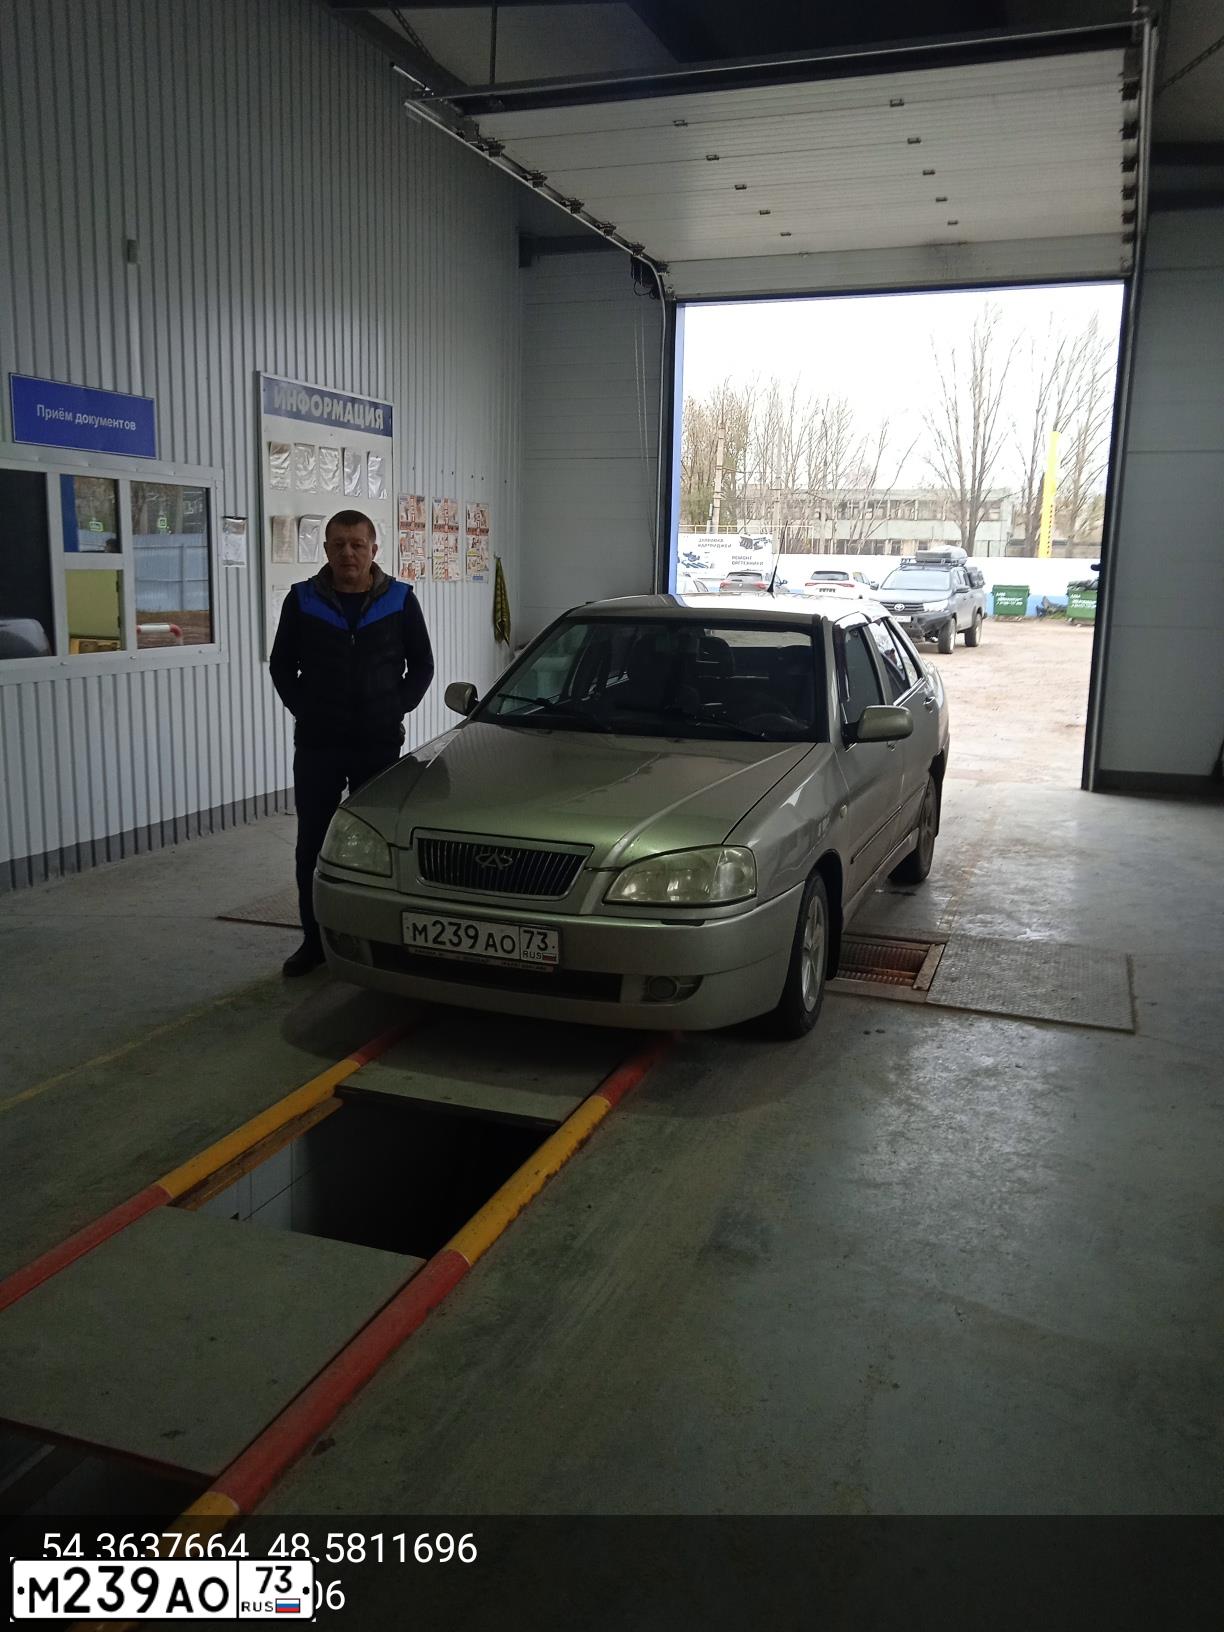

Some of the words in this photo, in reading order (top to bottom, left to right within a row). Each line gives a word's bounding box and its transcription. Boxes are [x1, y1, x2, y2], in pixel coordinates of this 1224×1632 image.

[36, 404, 73, 421] Приём
[75, 413, 137, 431] документов
[273, 385, 384, 429] ИНФОРМАЦИЯ
[412, 920, 516, 953] М239АО
[523, 929, 549, 950] 73
[522, 950, 543, 960] RUS
